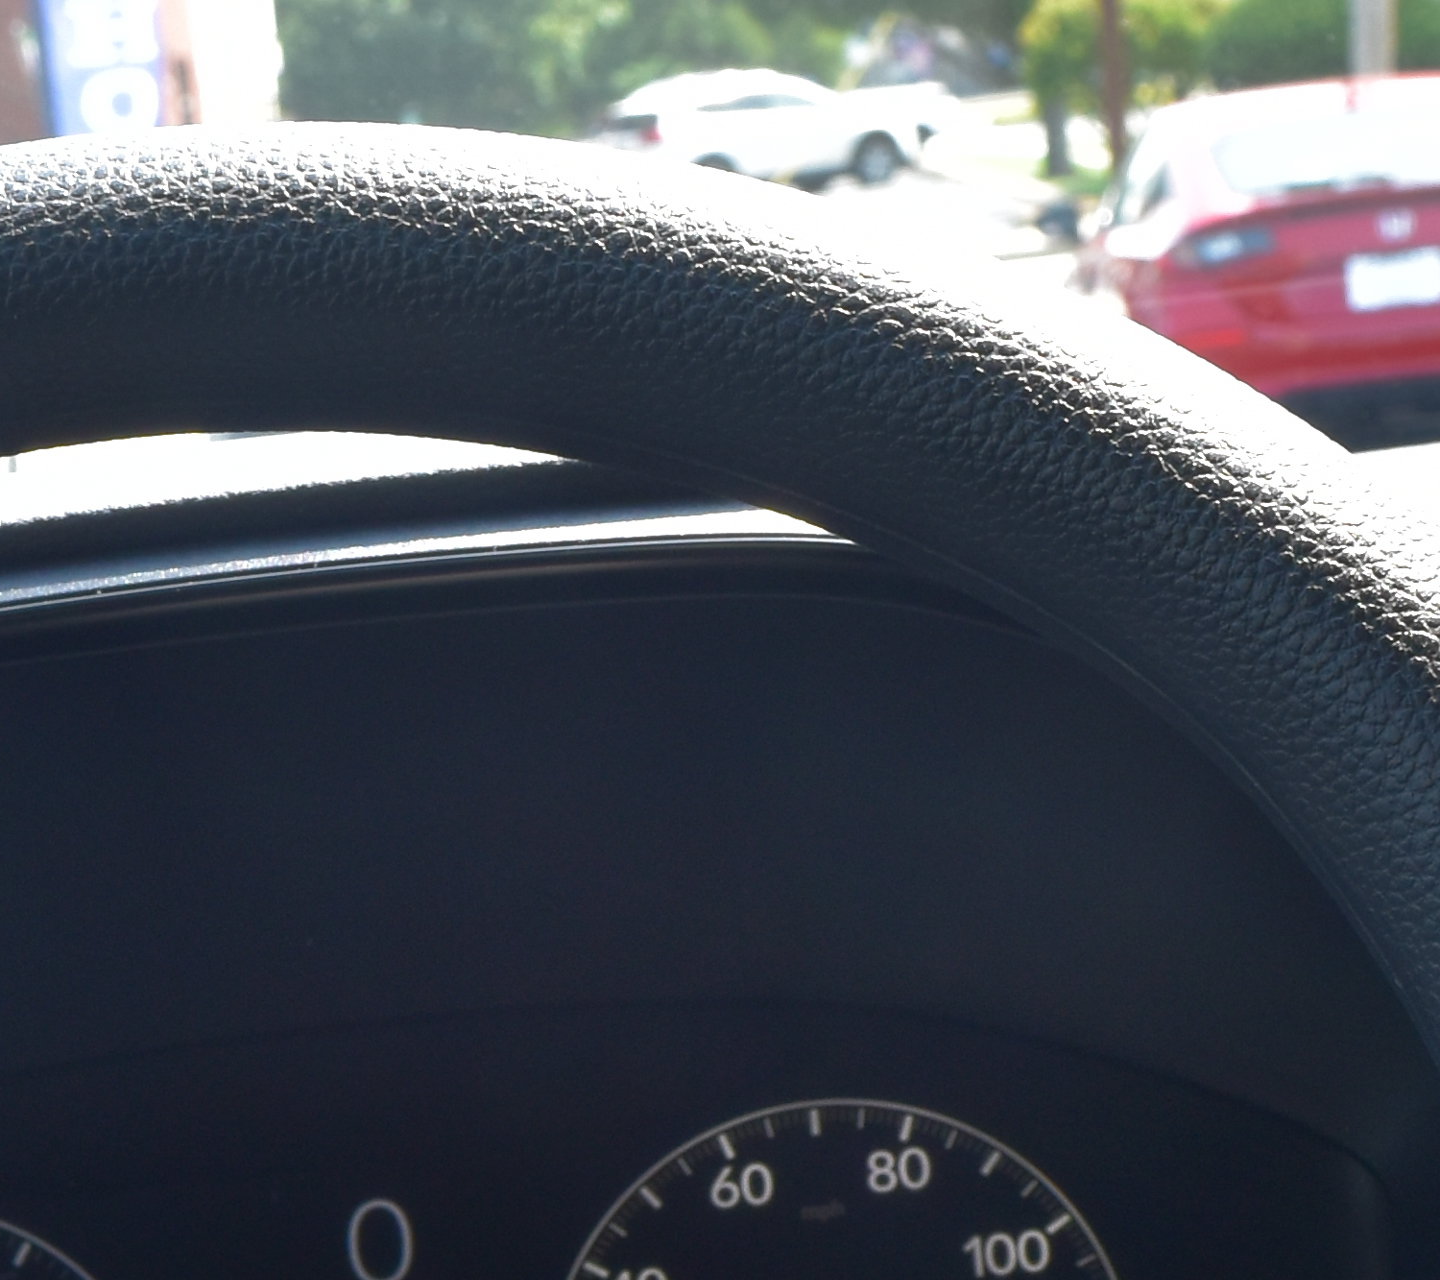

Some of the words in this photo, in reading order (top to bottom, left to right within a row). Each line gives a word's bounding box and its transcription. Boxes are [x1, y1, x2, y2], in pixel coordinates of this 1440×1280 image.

[710, 1161, 775, 1211] 60
[866, 1147, 931, 1195] 80
[962, 1230, 1050, 1277] 100
